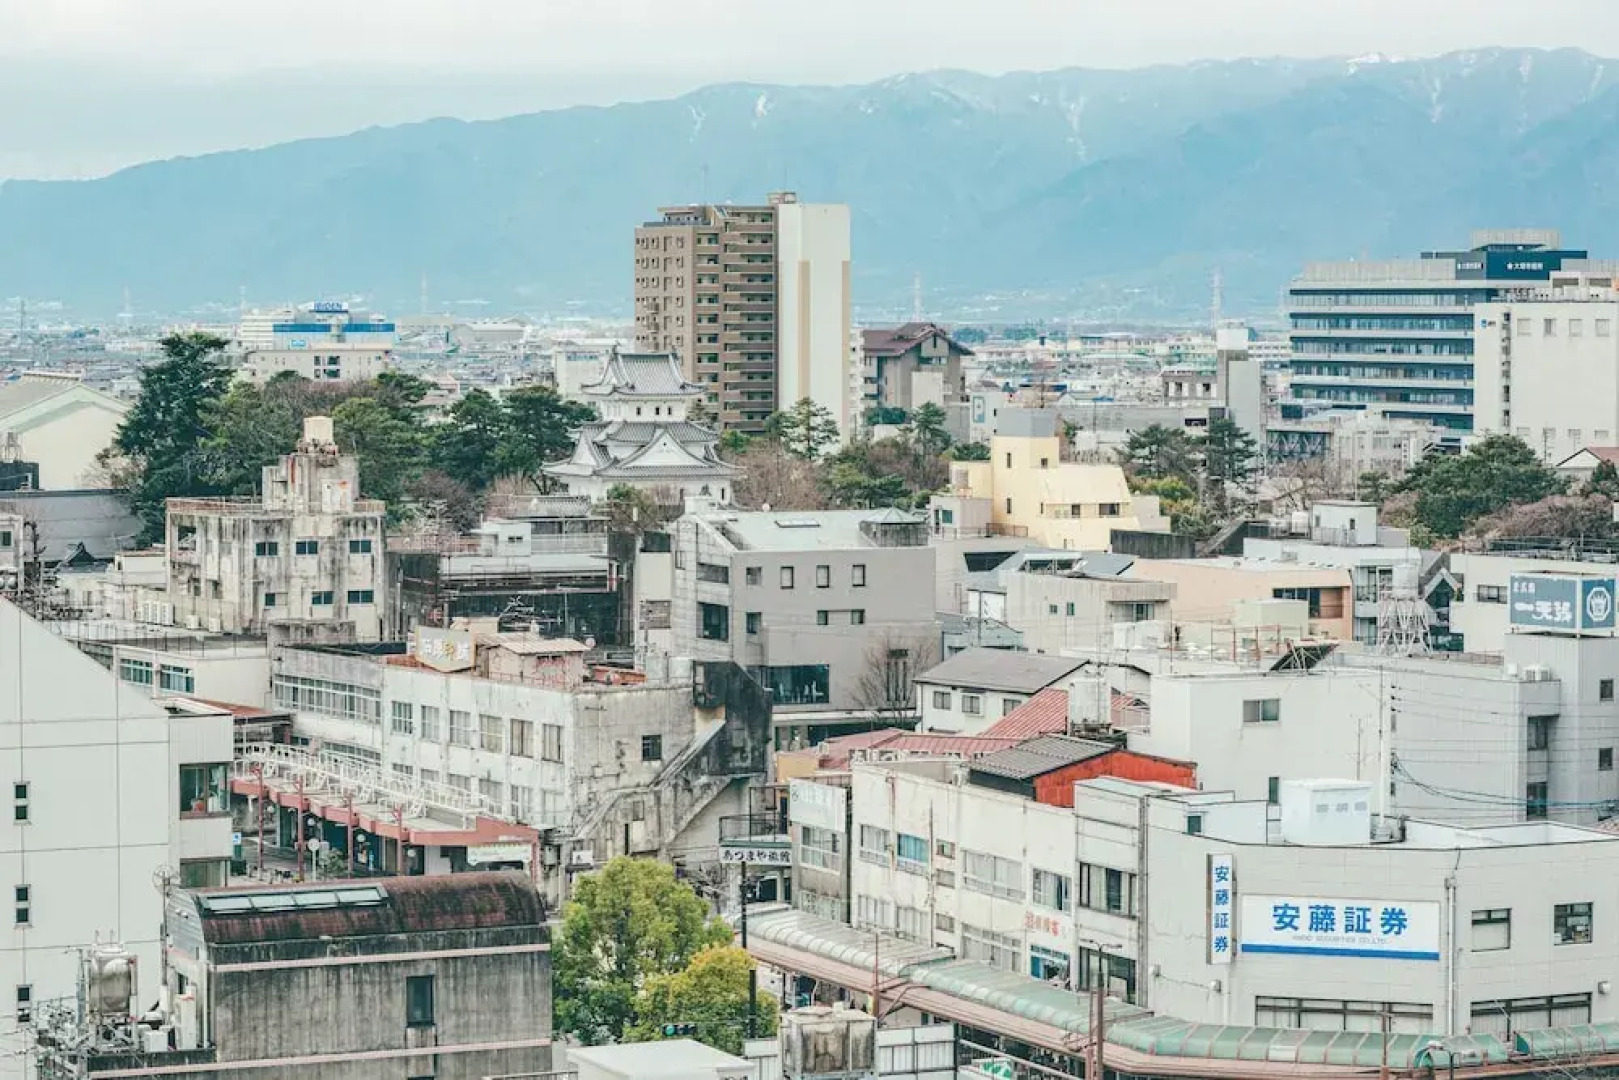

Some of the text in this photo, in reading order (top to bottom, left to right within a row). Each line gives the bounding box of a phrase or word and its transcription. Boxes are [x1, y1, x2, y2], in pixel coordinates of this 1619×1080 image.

[1214, 865, 1230, 953] 安藤証券
[1271, 903, 1408, 936] 安藤証券
